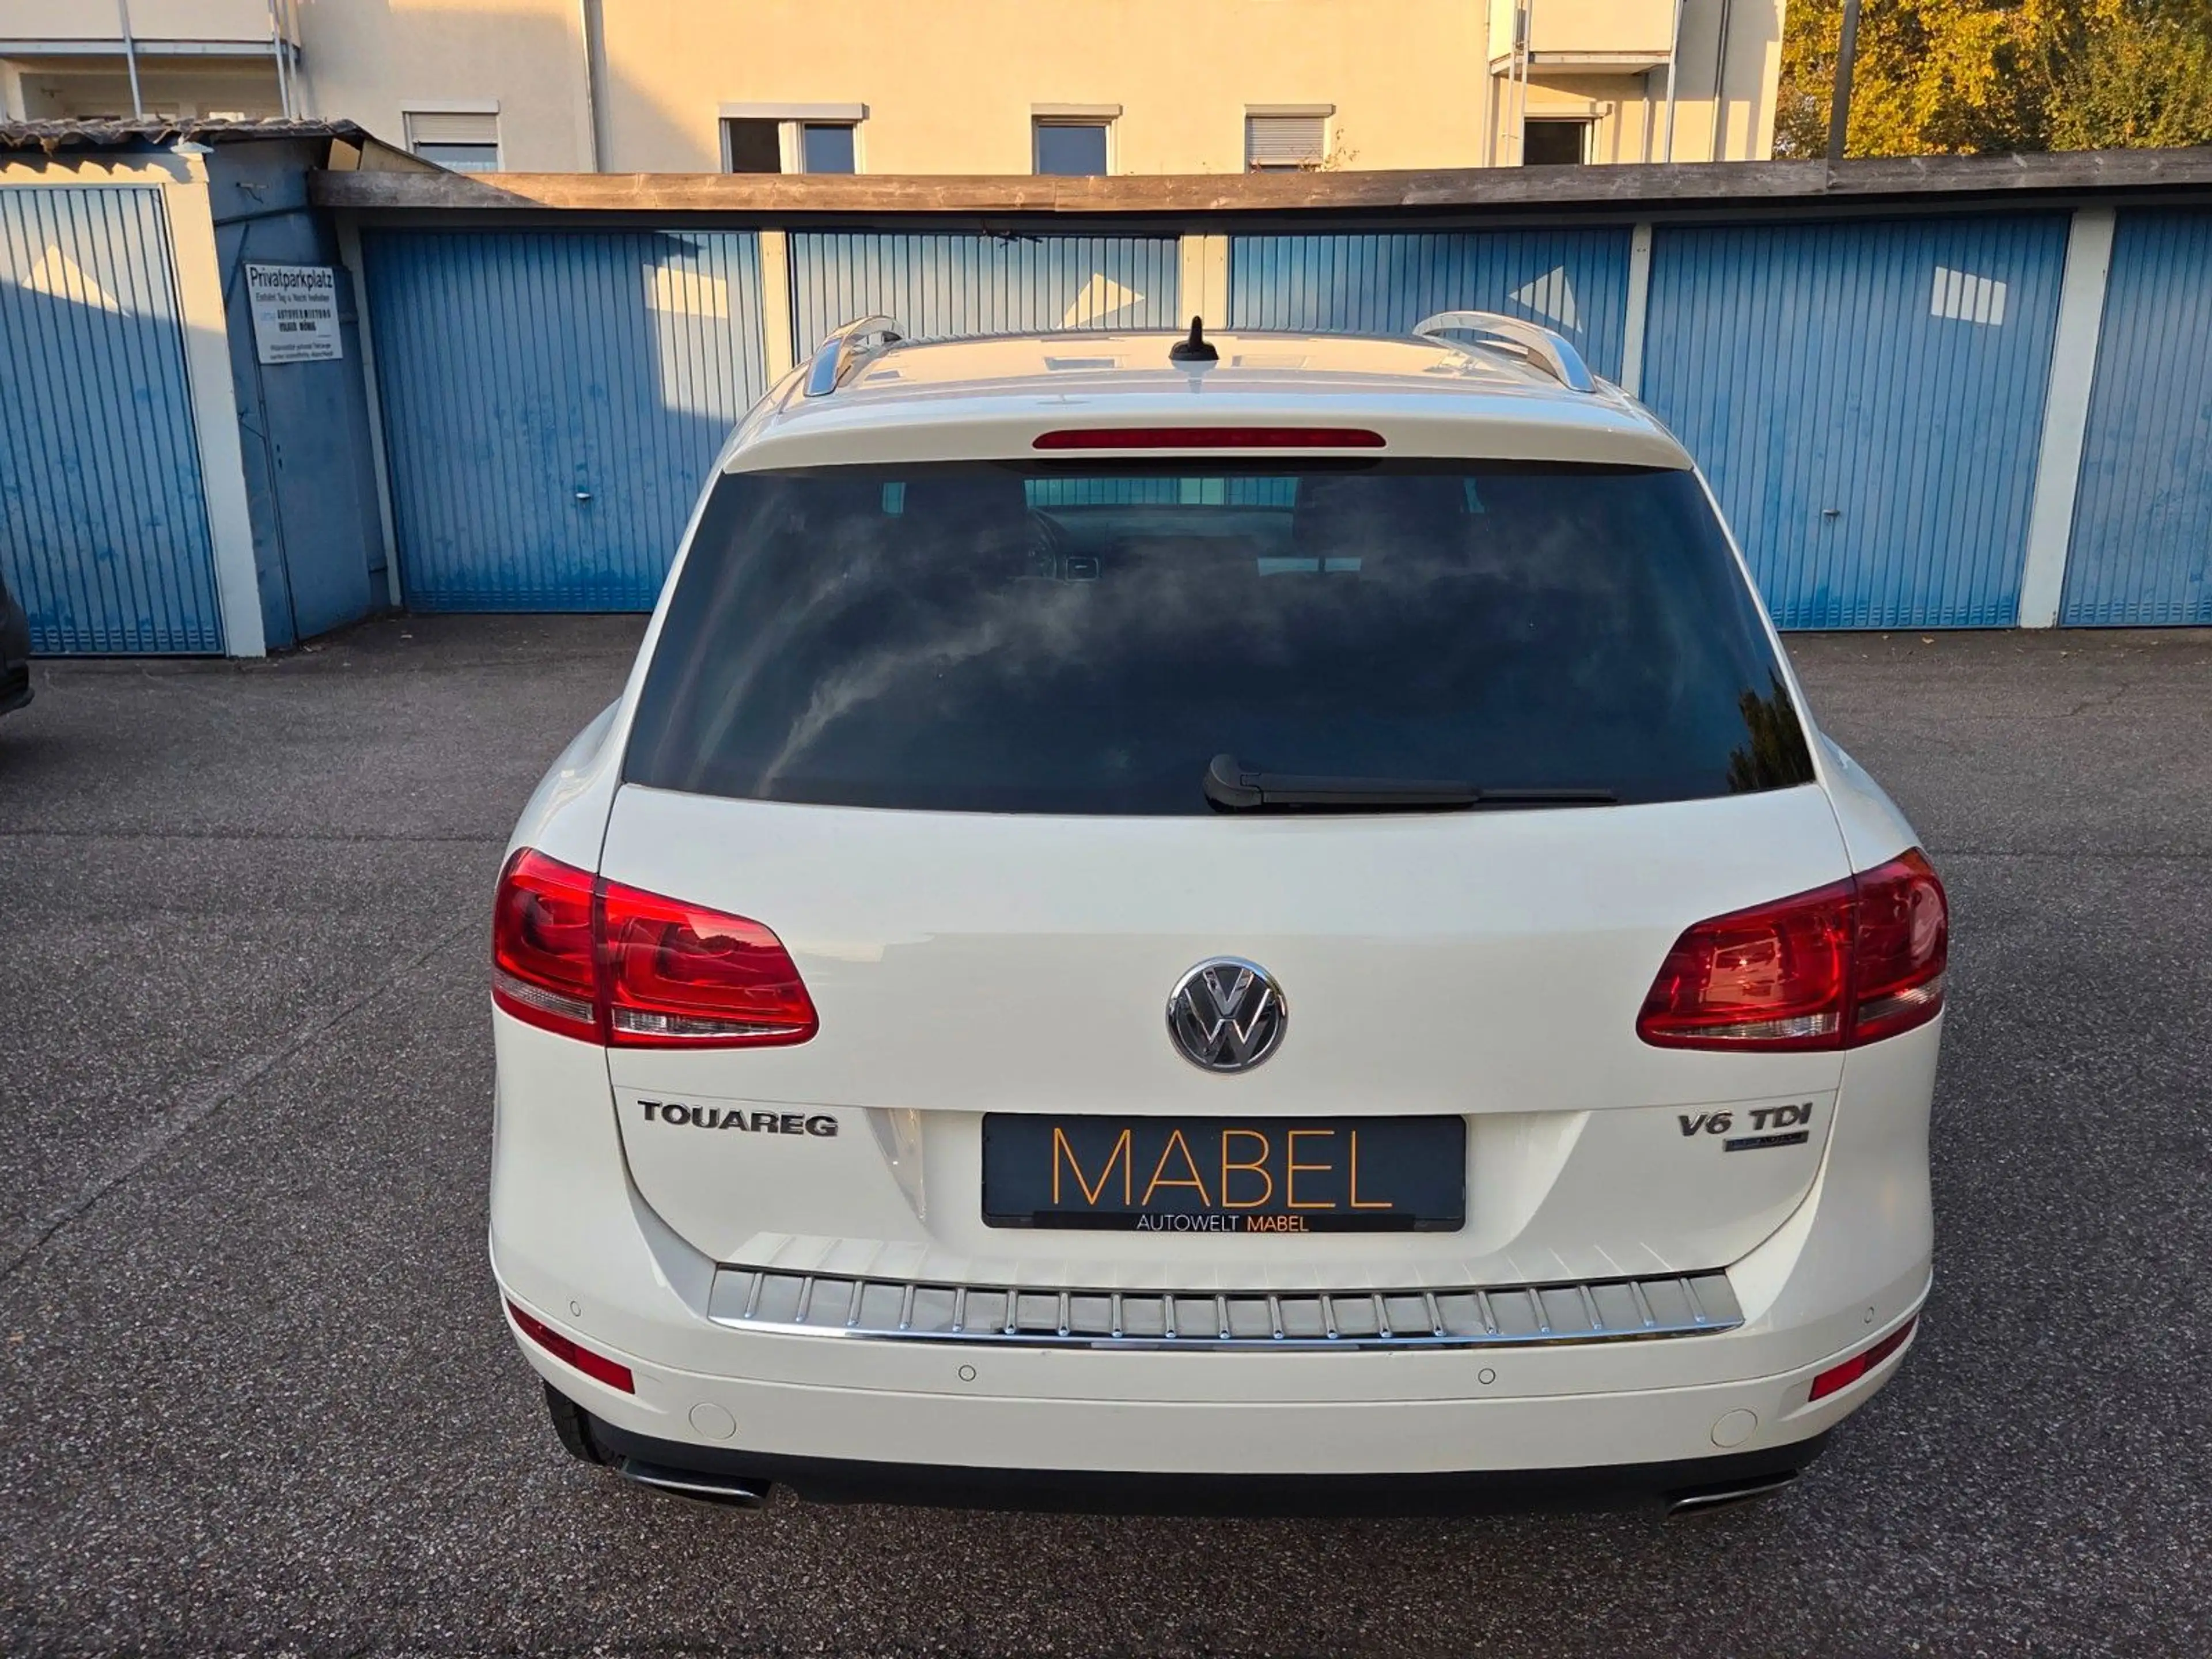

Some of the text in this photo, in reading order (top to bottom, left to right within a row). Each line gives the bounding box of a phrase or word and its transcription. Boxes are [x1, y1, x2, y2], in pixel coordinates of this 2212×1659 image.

[250, 267, 332, 291] Privatparkplatz
[1175, 963, 1280, 1067] VW
[637, 1099, 839, 1137] TOUAREG
[1677, 1101, 1813, 1137] V6 TDI
[1051, 1127, 1393, 1209] MABEL
[1137, 1215, 1309, 1232] AUTOWELT MABEL
